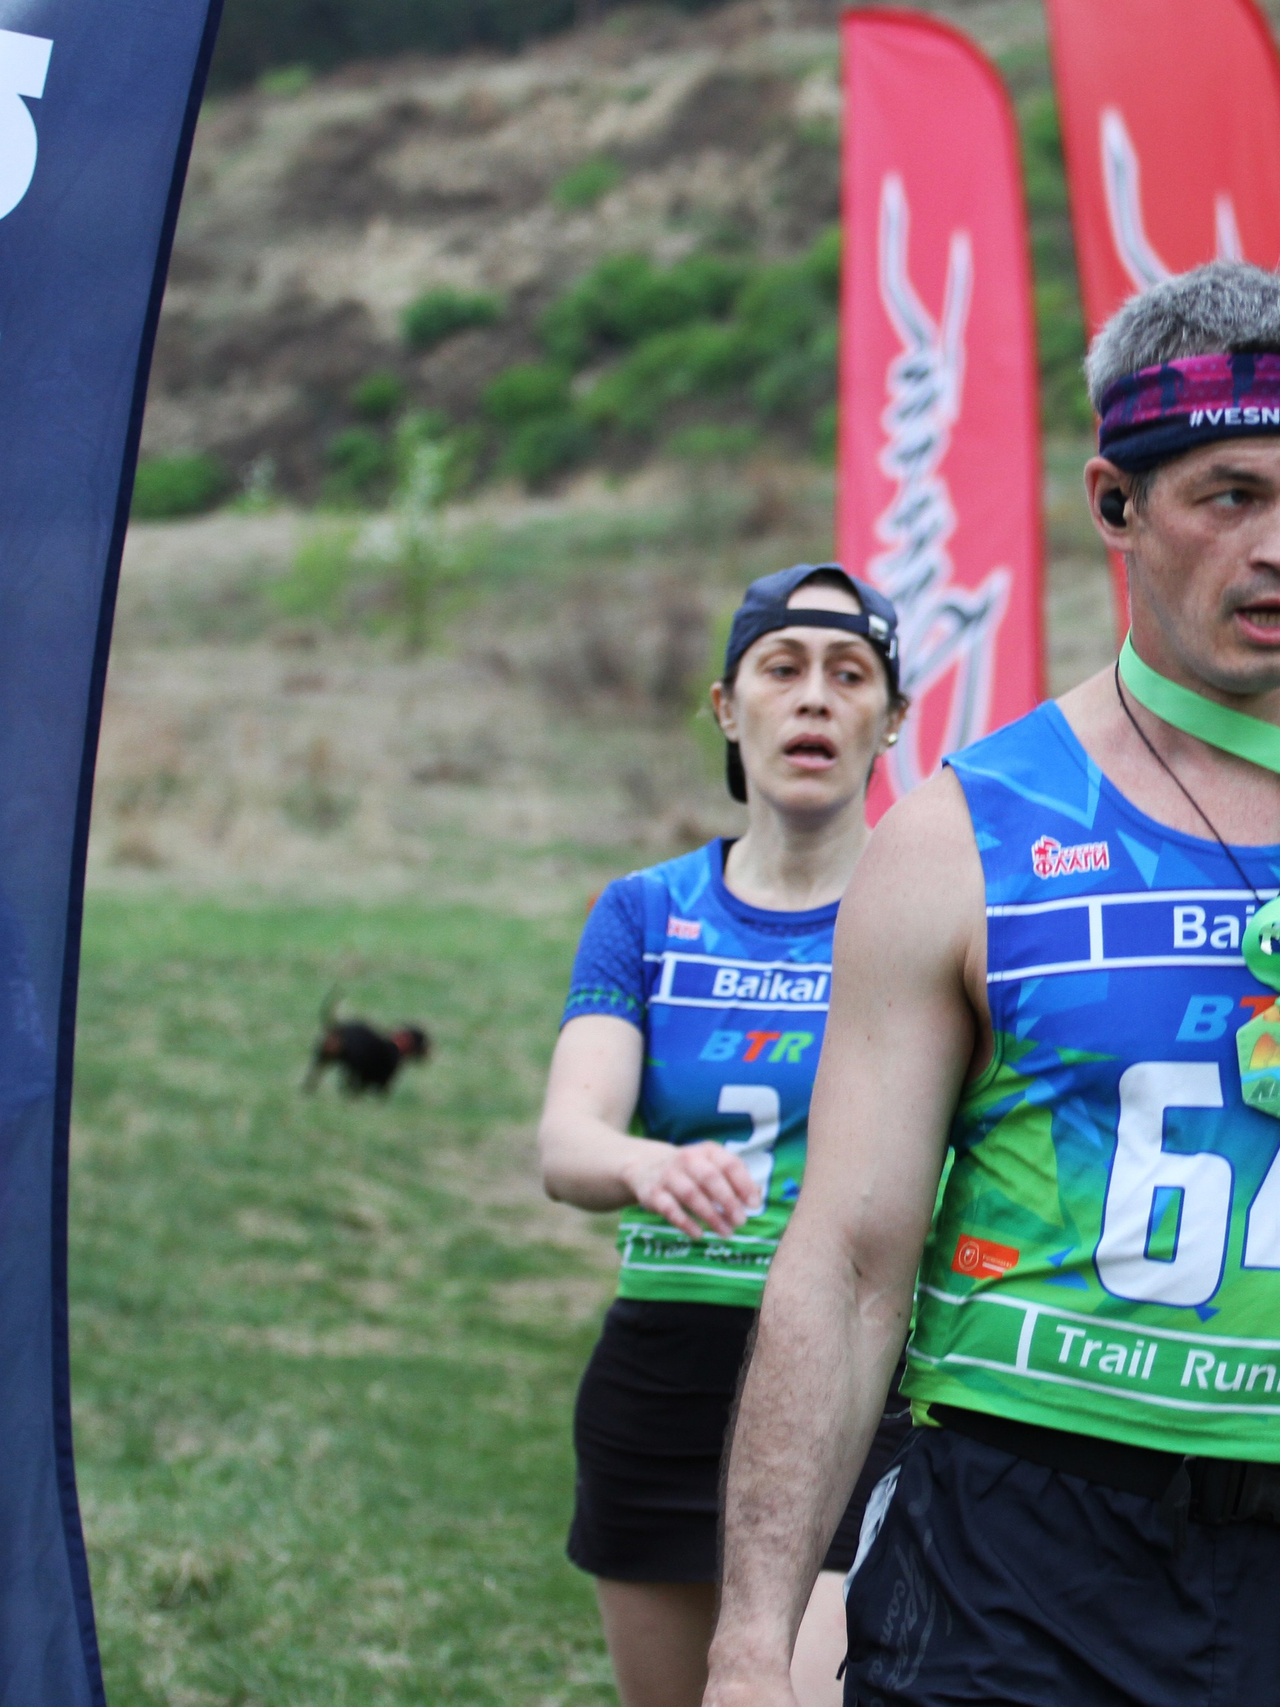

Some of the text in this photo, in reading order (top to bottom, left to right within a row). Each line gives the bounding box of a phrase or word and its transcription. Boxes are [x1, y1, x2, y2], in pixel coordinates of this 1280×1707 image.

[711, 967, 829, 1002] Baikal
[699, 1029, 814, 1064] BTR
[1056, 1323, 1159, 1381] Trail
